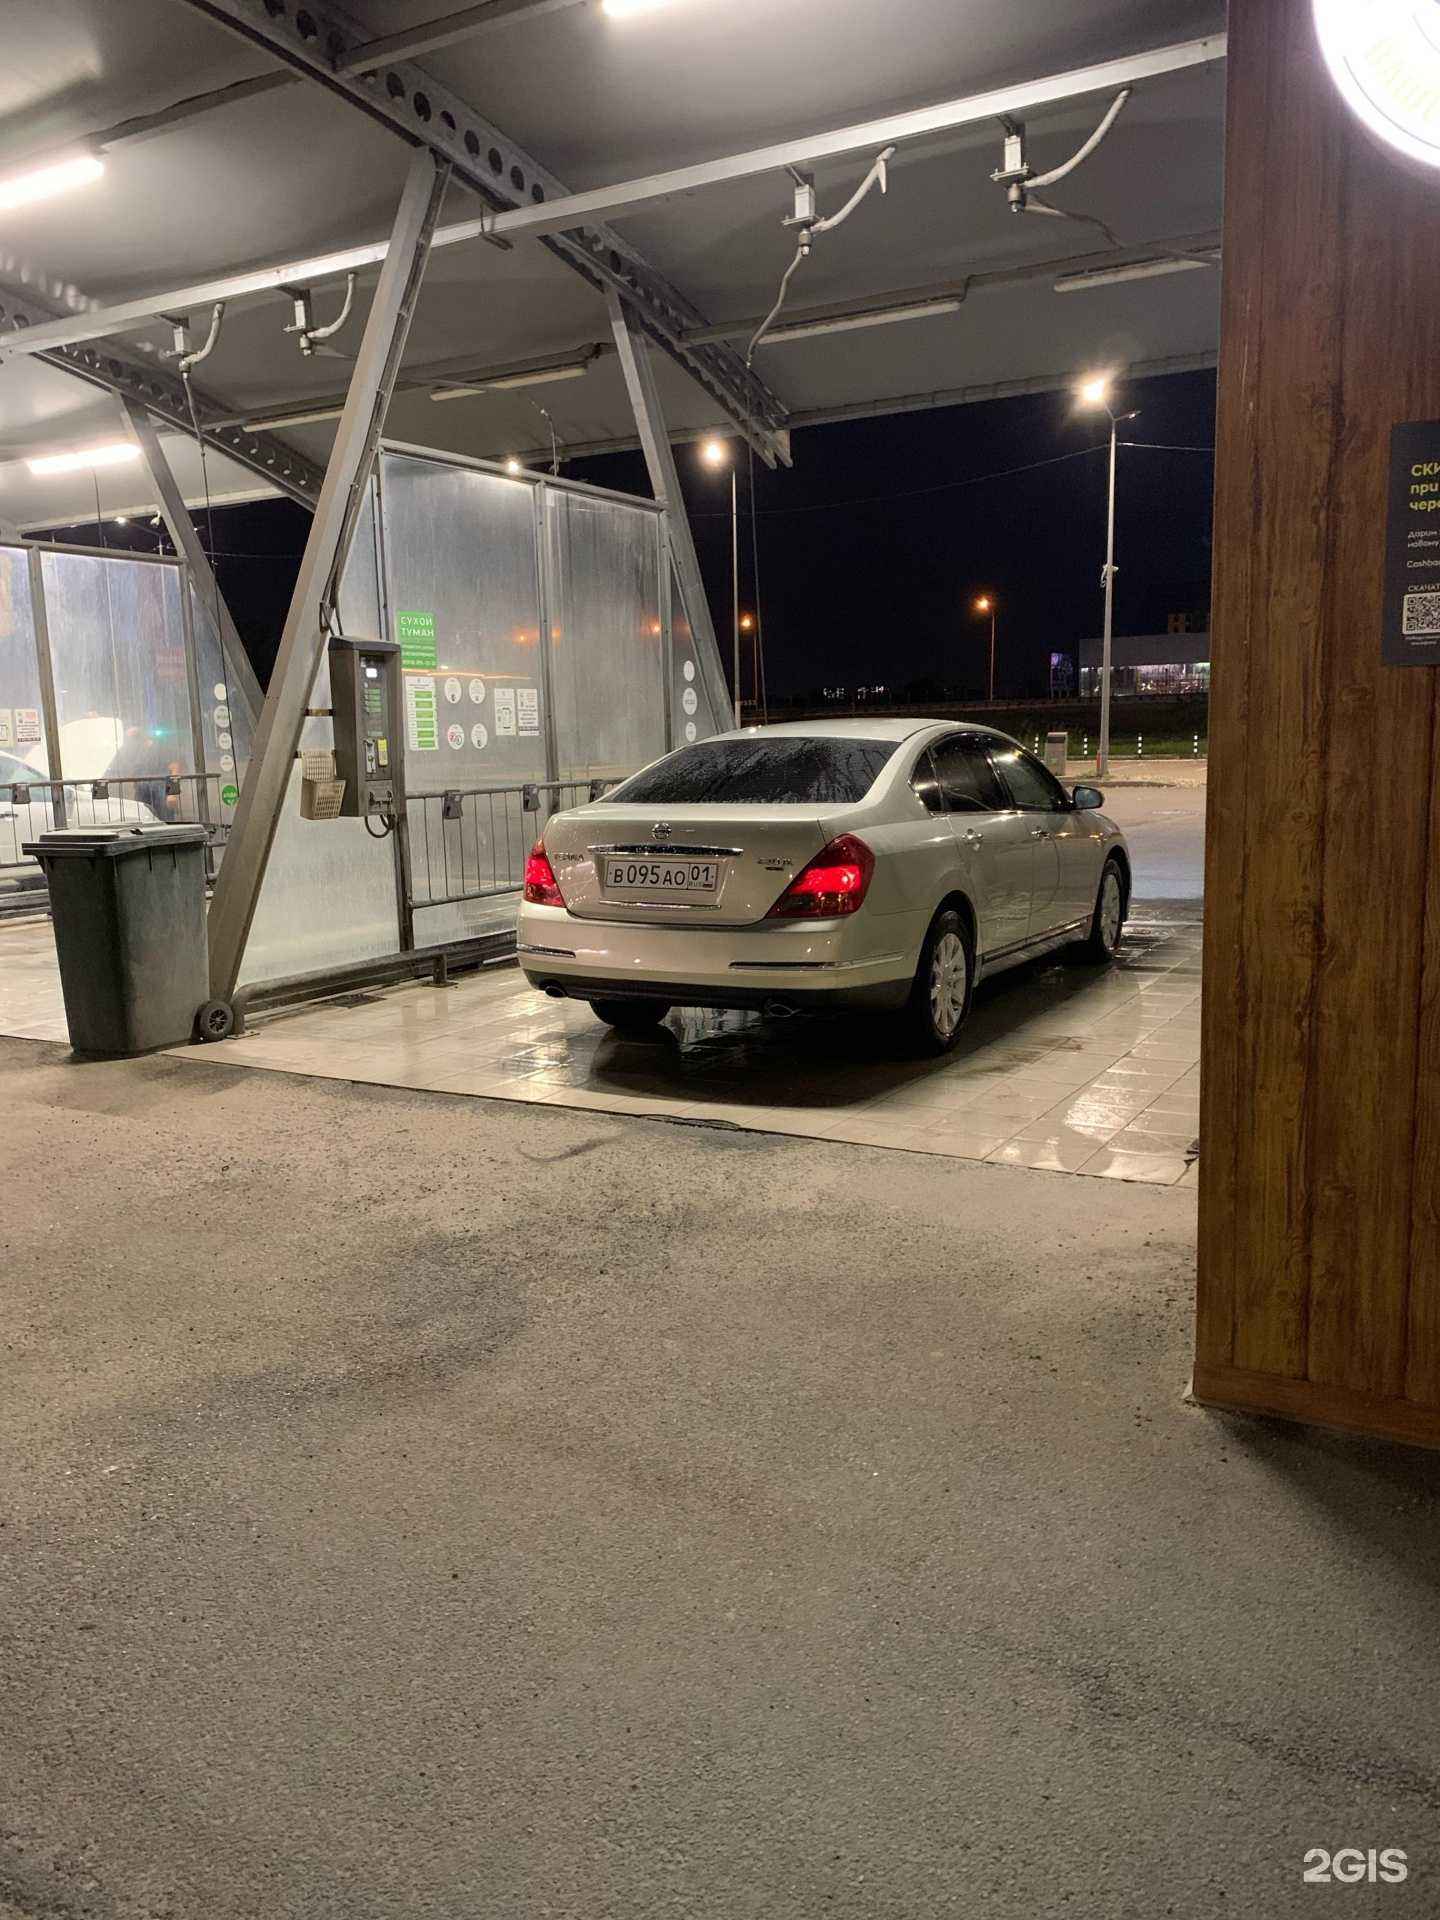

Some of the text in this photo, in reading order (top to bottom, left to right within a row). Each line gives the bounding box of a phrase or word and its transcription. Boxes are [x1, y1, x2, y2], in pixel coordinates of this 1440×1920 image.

[1410, 482, 1439, 496] при
[401, 615, 432, 626] СУХОЙ
[401, 627, 434, 637] ТУМАН
[691, 866, 710, 881] 01
